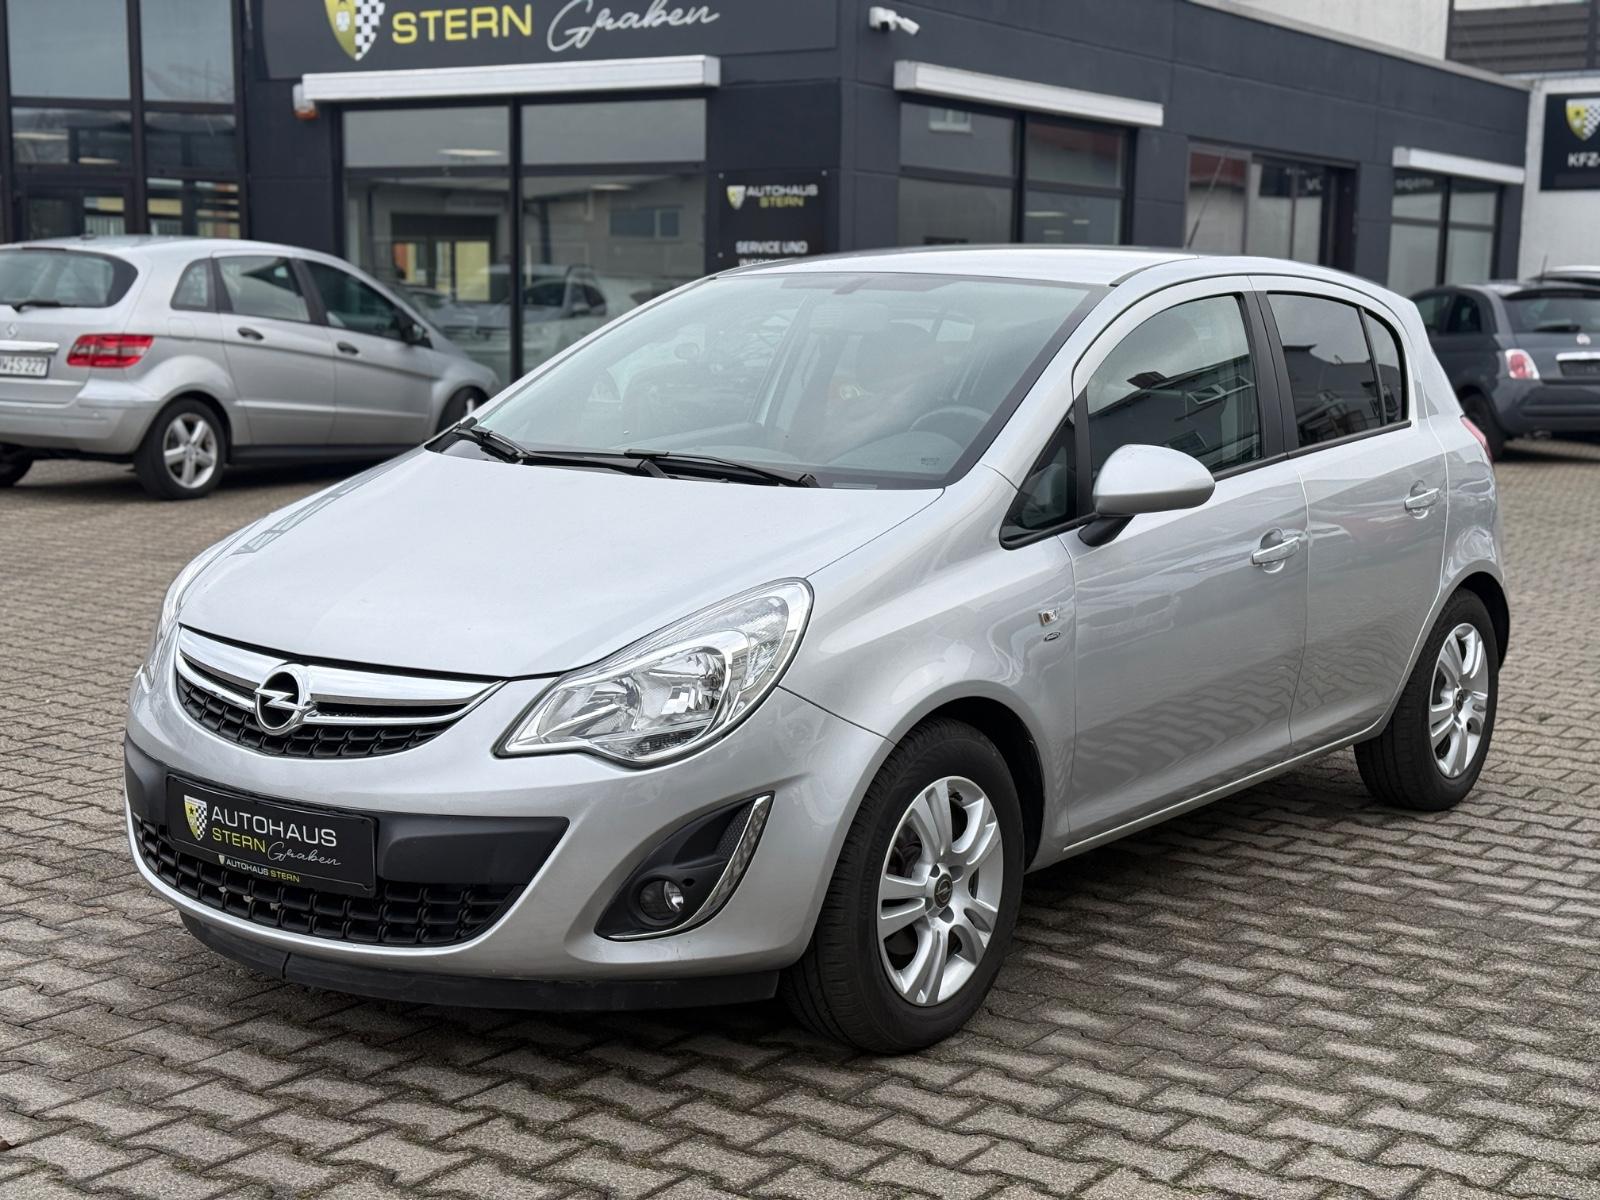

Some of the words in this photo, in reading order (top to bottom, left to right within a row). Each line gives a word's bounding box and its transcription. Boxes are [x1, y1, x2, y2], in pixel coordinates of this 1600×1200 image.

[392, 4, 533, 44] STERN
[546, 0, 720, 52] Graben
[746, 184, 819, 197] AUTOHAUS
[759, 196, 804, 209] STERN
[735, 240, 780, 255] SERVICE
[782, 240, 808, 254] UND
[211, 806, 338, 847] AUTOHAUS
[212, 827, 266, 853] STERN
[267, 841, 341, 865] Graben
[226, 858, 269, 876] AUTOHAUS
[270, 868, 300, 883] STERN
